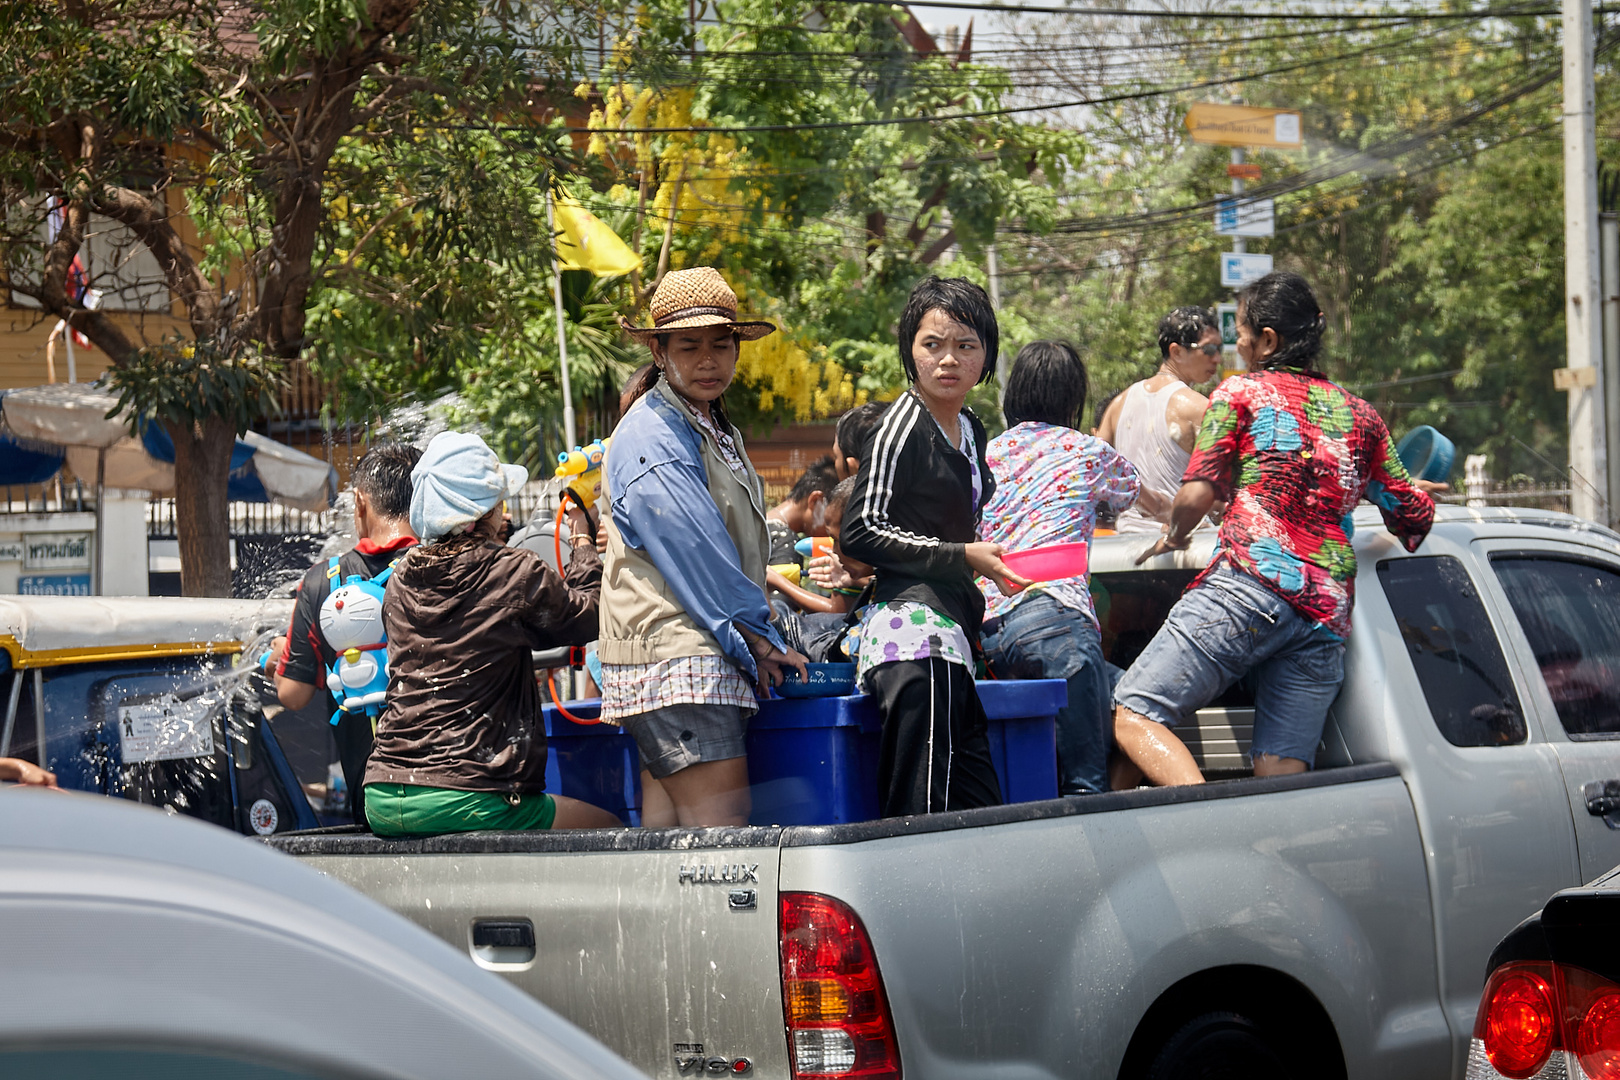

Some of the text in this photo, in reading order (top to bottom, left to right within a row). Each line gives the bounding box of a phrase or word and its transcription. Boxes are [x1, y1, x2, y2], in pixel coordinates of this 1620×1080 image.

[679, 864, 758, 883] HILUX
[673, 1044, 704, 1053] HILUX
[675, 1056, 752, 1074] VIGO
